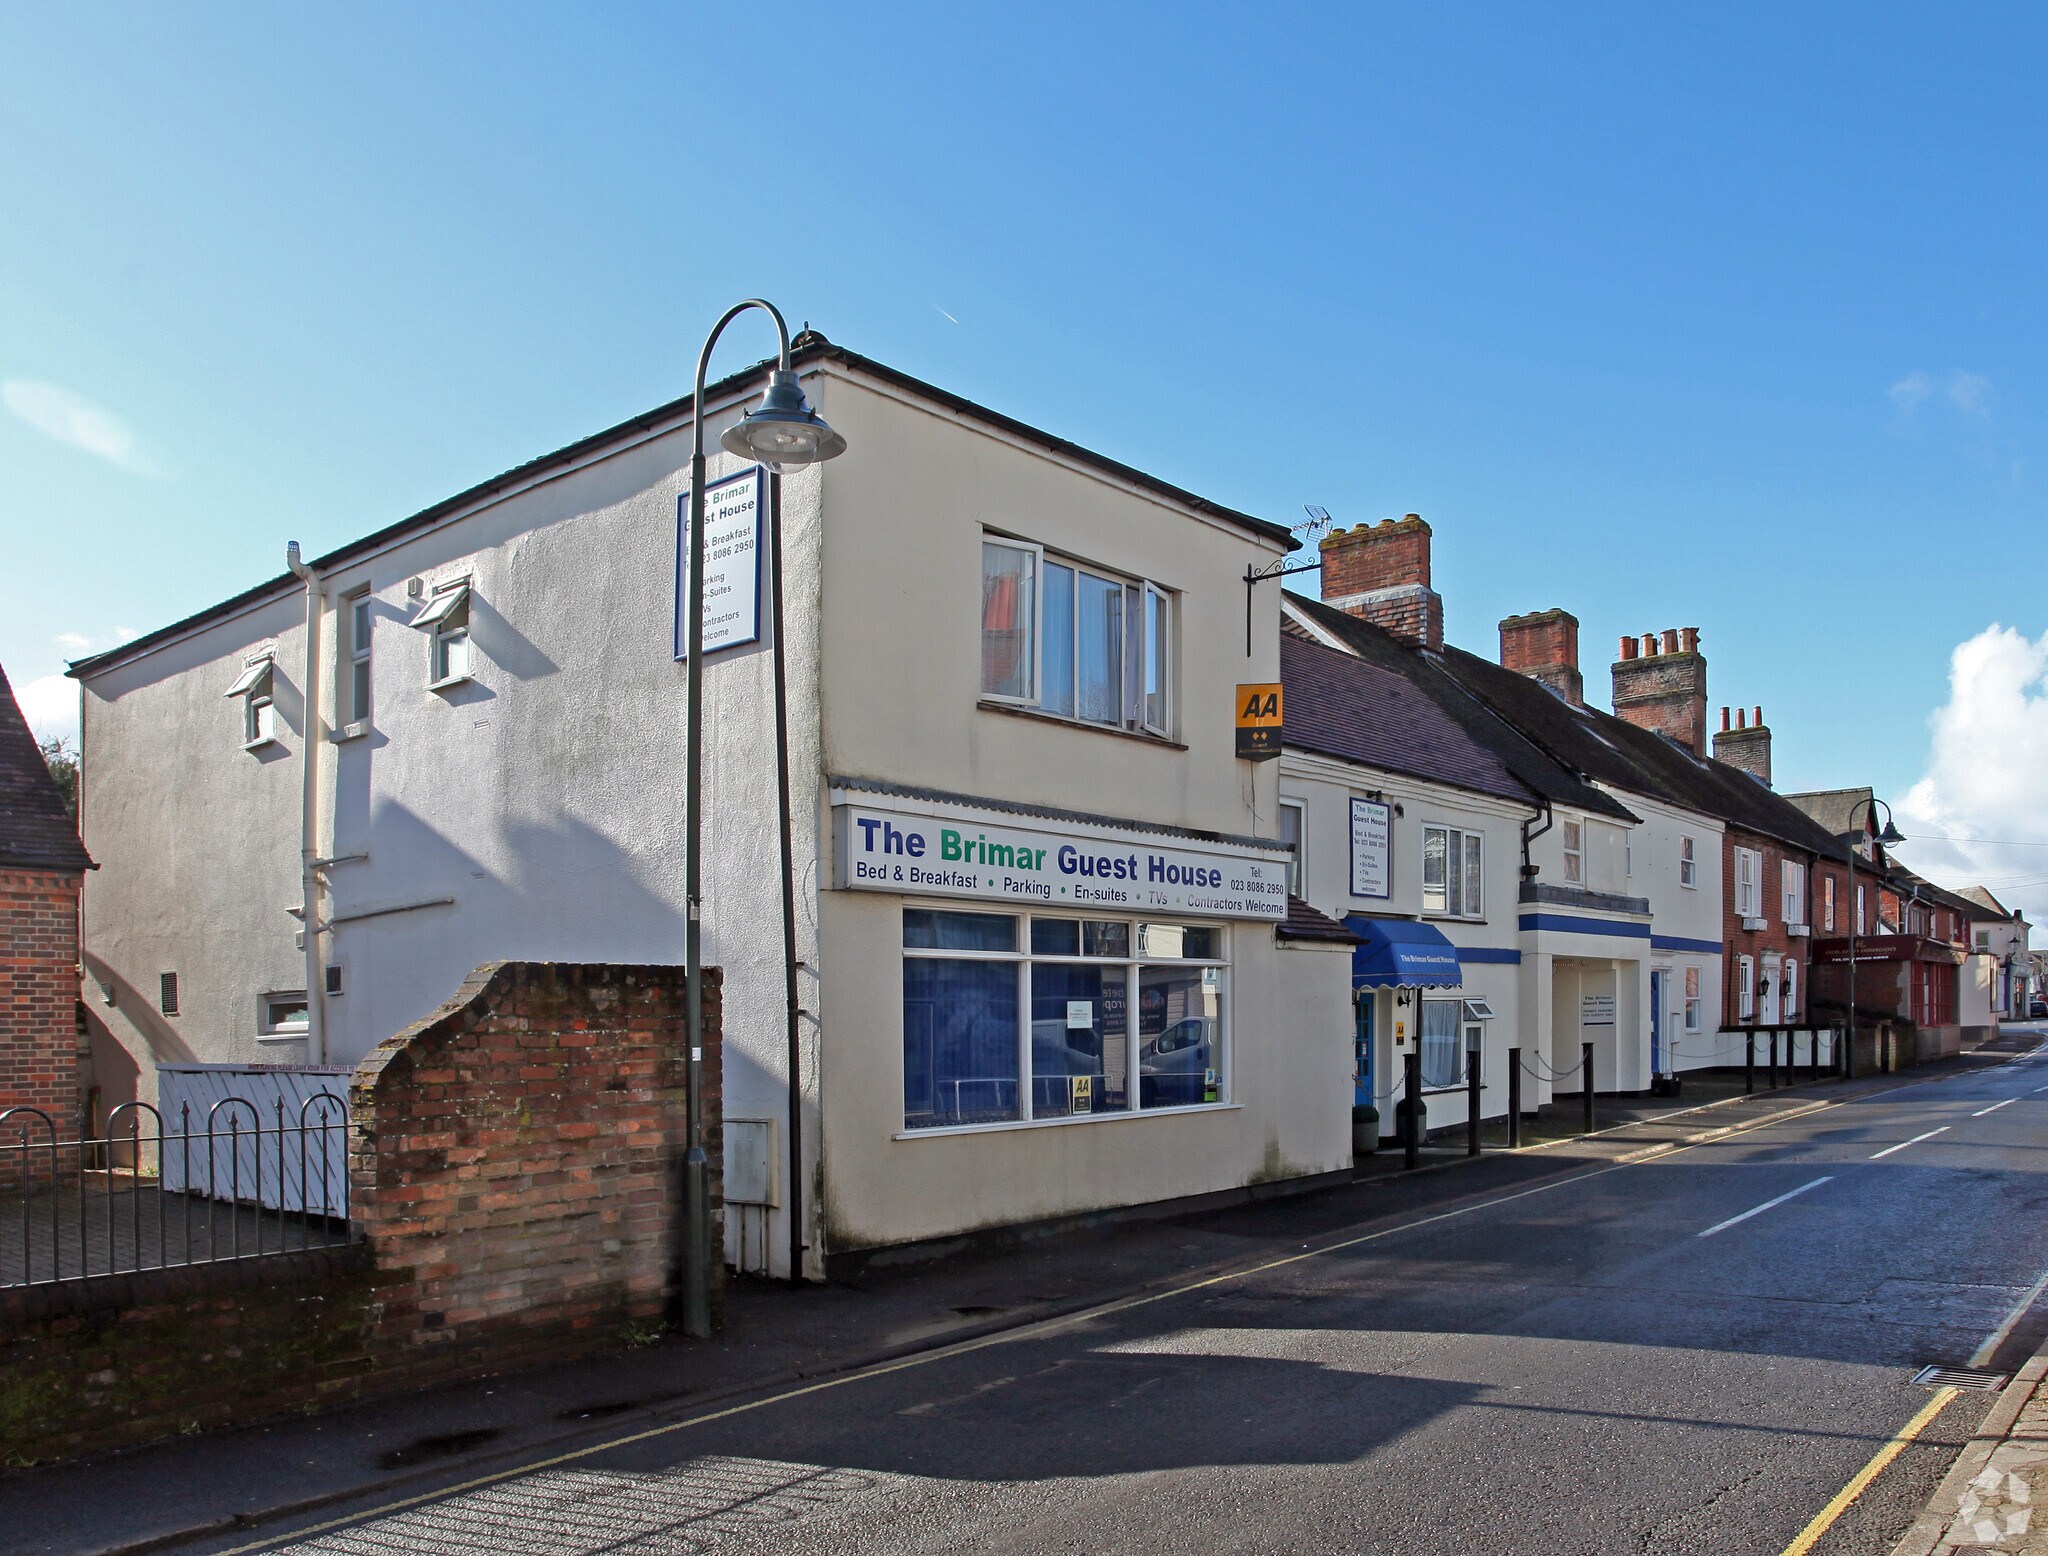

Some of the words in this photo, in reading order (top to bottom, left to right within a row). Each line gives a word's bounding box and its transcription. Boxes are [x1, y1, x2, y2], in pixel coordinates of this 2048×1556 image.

[713, 484, 750, 504] Brimar
[684, 512, 715, 531] Gst
[719, 500, 755, 520] House
[712, 526, 751, 547] Breakfast
[713, 546, 732, 561] 8086
[734, 539, 754, 554] 2950
[703, 573, 725, 586] arking
[703, 585, 732, 600] n-Suites
[703, 605, 712, 613] Vs
[703, 611, 740, 628] ontractors
[703, 628, 730, 642] elcome
[1242, 693, 1277, 718] AA
[1356, 804, 1366, 813] The
[1367, 807, 1384, 816] Brimar
[1354, 814, 1370, 824] Guest
[1371, 817, 1387, 827] House
[857, 817, 926, 858] The
[941, 828, 1047, 871] Brimar
[1058, 845, 1137, 881] Guest
[1148, 855, 1222, 889] House
[1250, 866, 1262, 878] Tel:
[856, 862, 887, 880] Bed
[893, 865, 904, 881] &
[910, 867, 977, 888] Breakfast
[1003, 877, 1051, 899] Parking
[1075, 884, 1127, 902] En-suites
[1149, 891, 1168, 905] TVs
[1187, 894, 1242, 911] Contractors
[1245, 899, 1284, 914] Welcome
[1231, 881, 1245, 892] 023
[1247, 883, 1265, 893] 8086
[1267, 884, 1284, 895] 2950
[1400, 954, 1410, 962] The
[1076, 1079, 1088, 1092] AA
